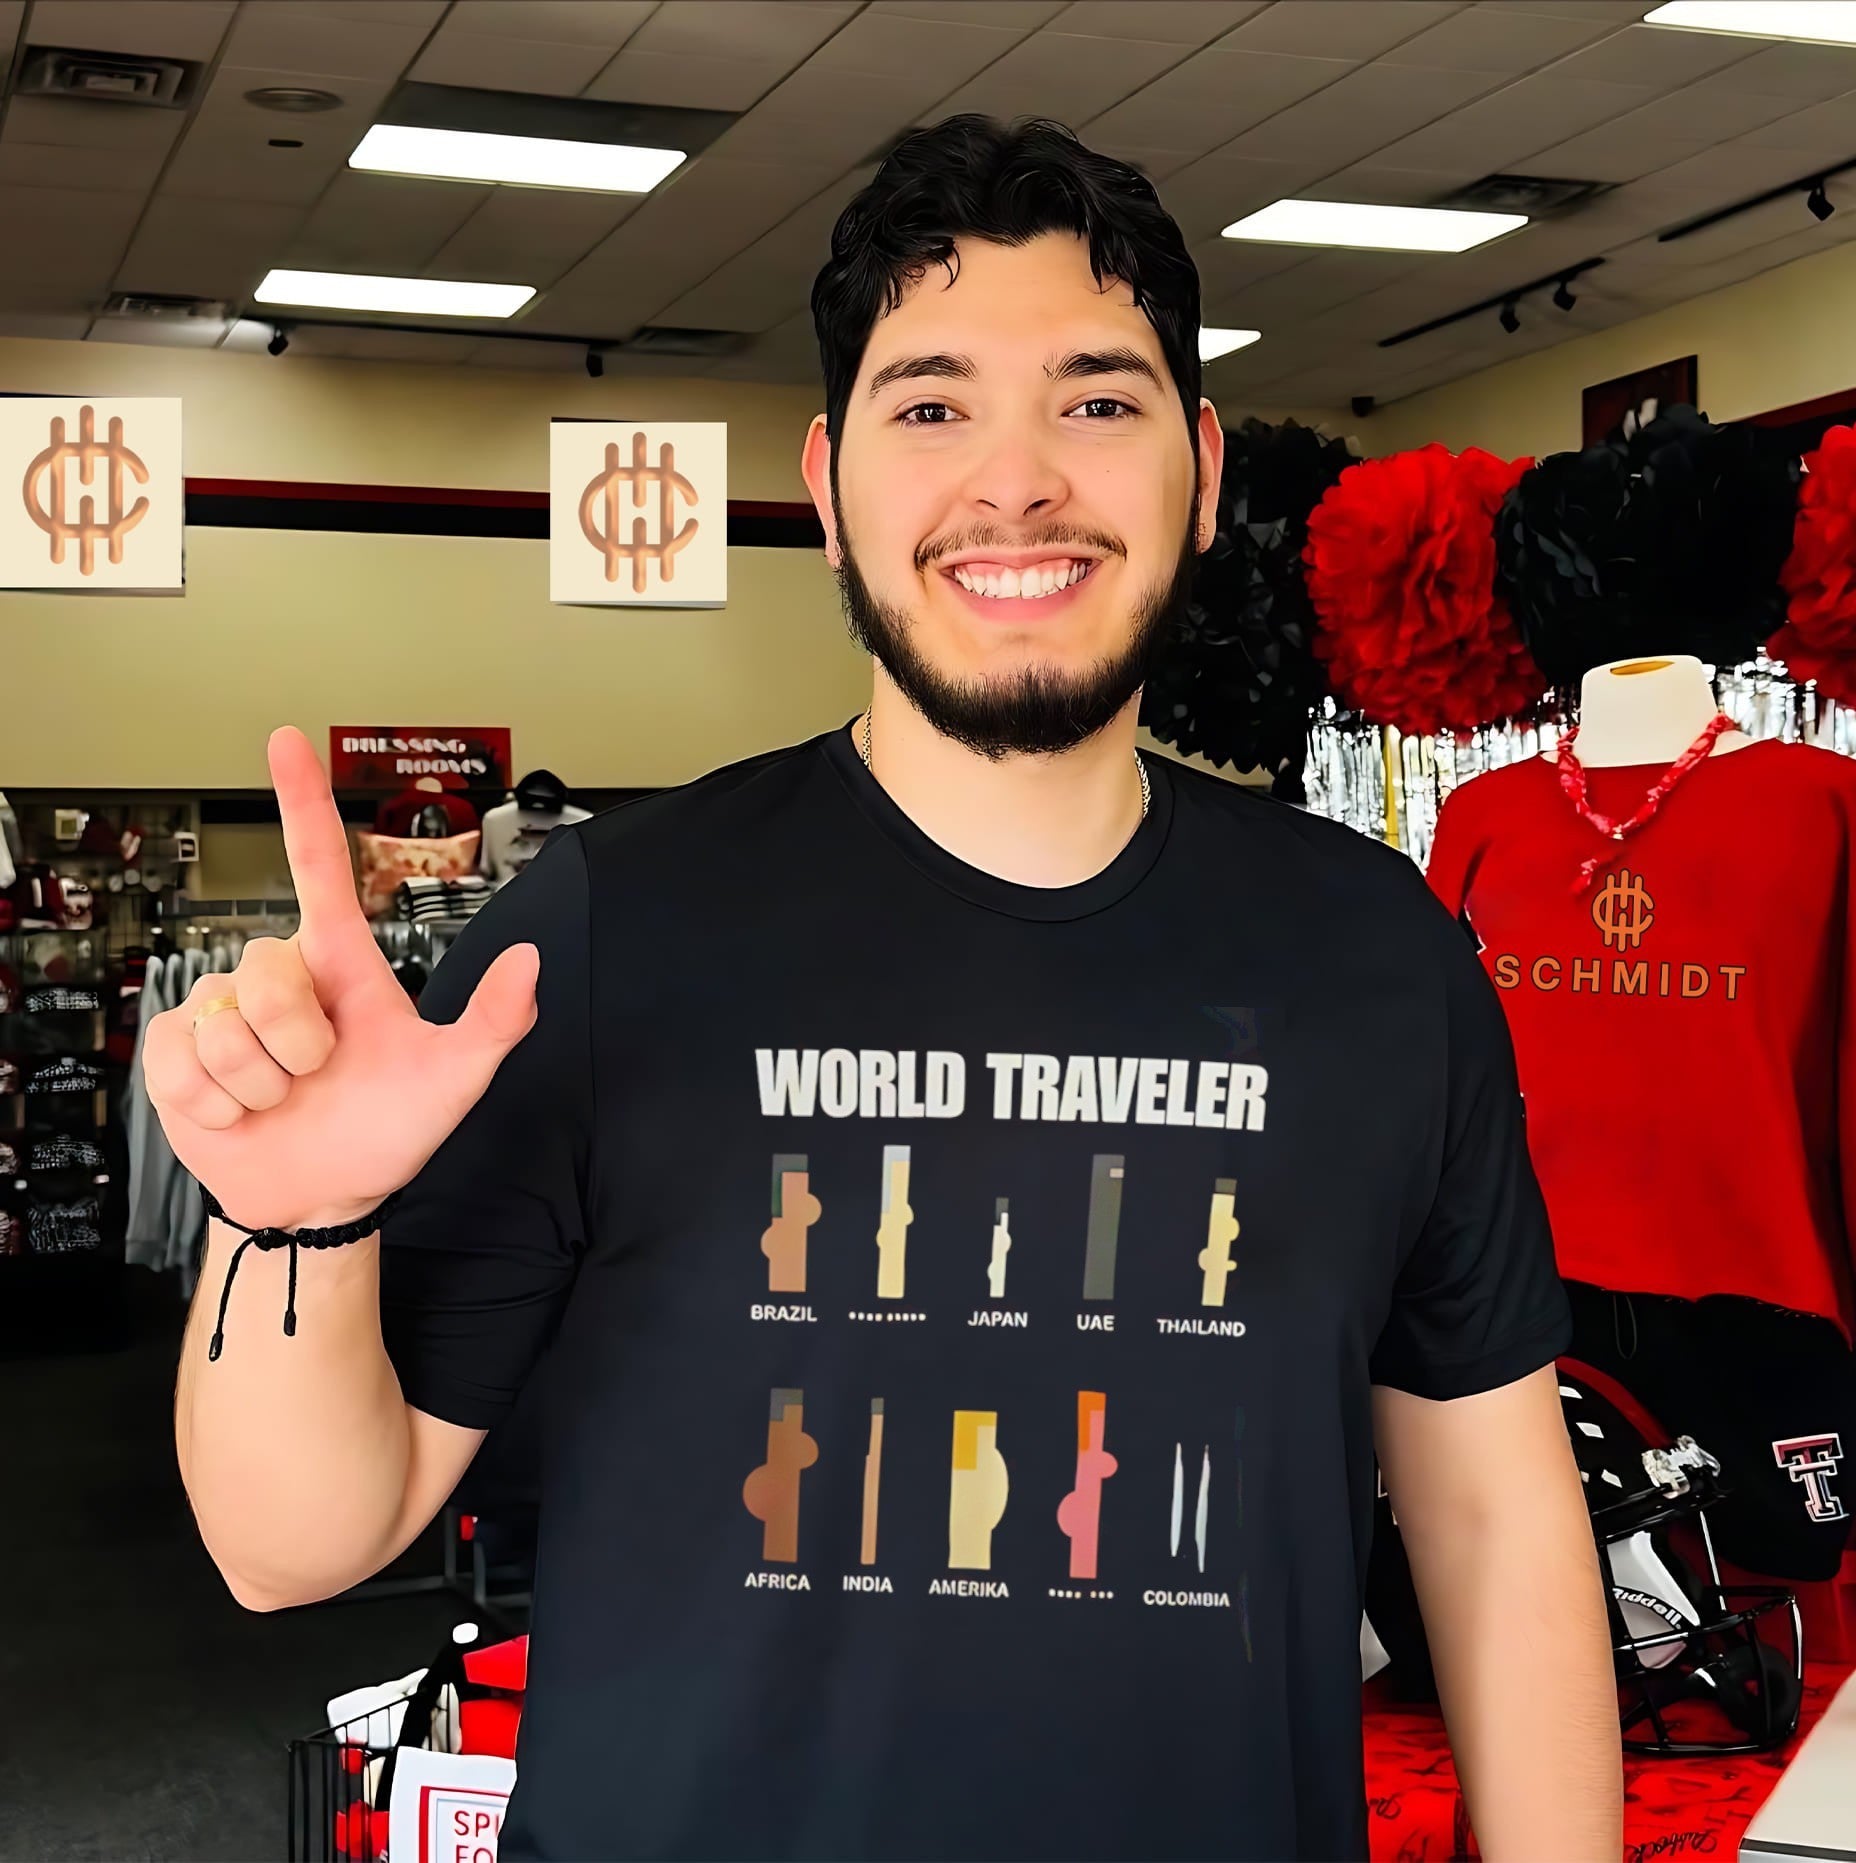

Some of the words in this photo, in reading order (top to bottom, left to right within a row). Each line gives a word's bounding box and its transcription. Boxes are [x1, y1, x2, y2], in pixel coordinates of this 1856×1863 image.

[1495, 955, 1746, 1000] SCHMIDT
[755, 1048, 966, 1119] WORLD
[986, 1053, 1269, 1132] TRAVELER
[750, 1304, 818, 1323] BRAZIL
[967, 1310, 1029, 1328] JAPAN
[1076, 1313, 1115, 1332] UAE
[1156, 1318, 1247, 1338] THAILAND
[744, 1572, 811, 1591] AFRICA
[842, 1574, 894, 1594] INDIA
[928, 1578, 1010, 1599] AMERIKA
[1142, 1589, 1231, 1608] COLOMBIA
